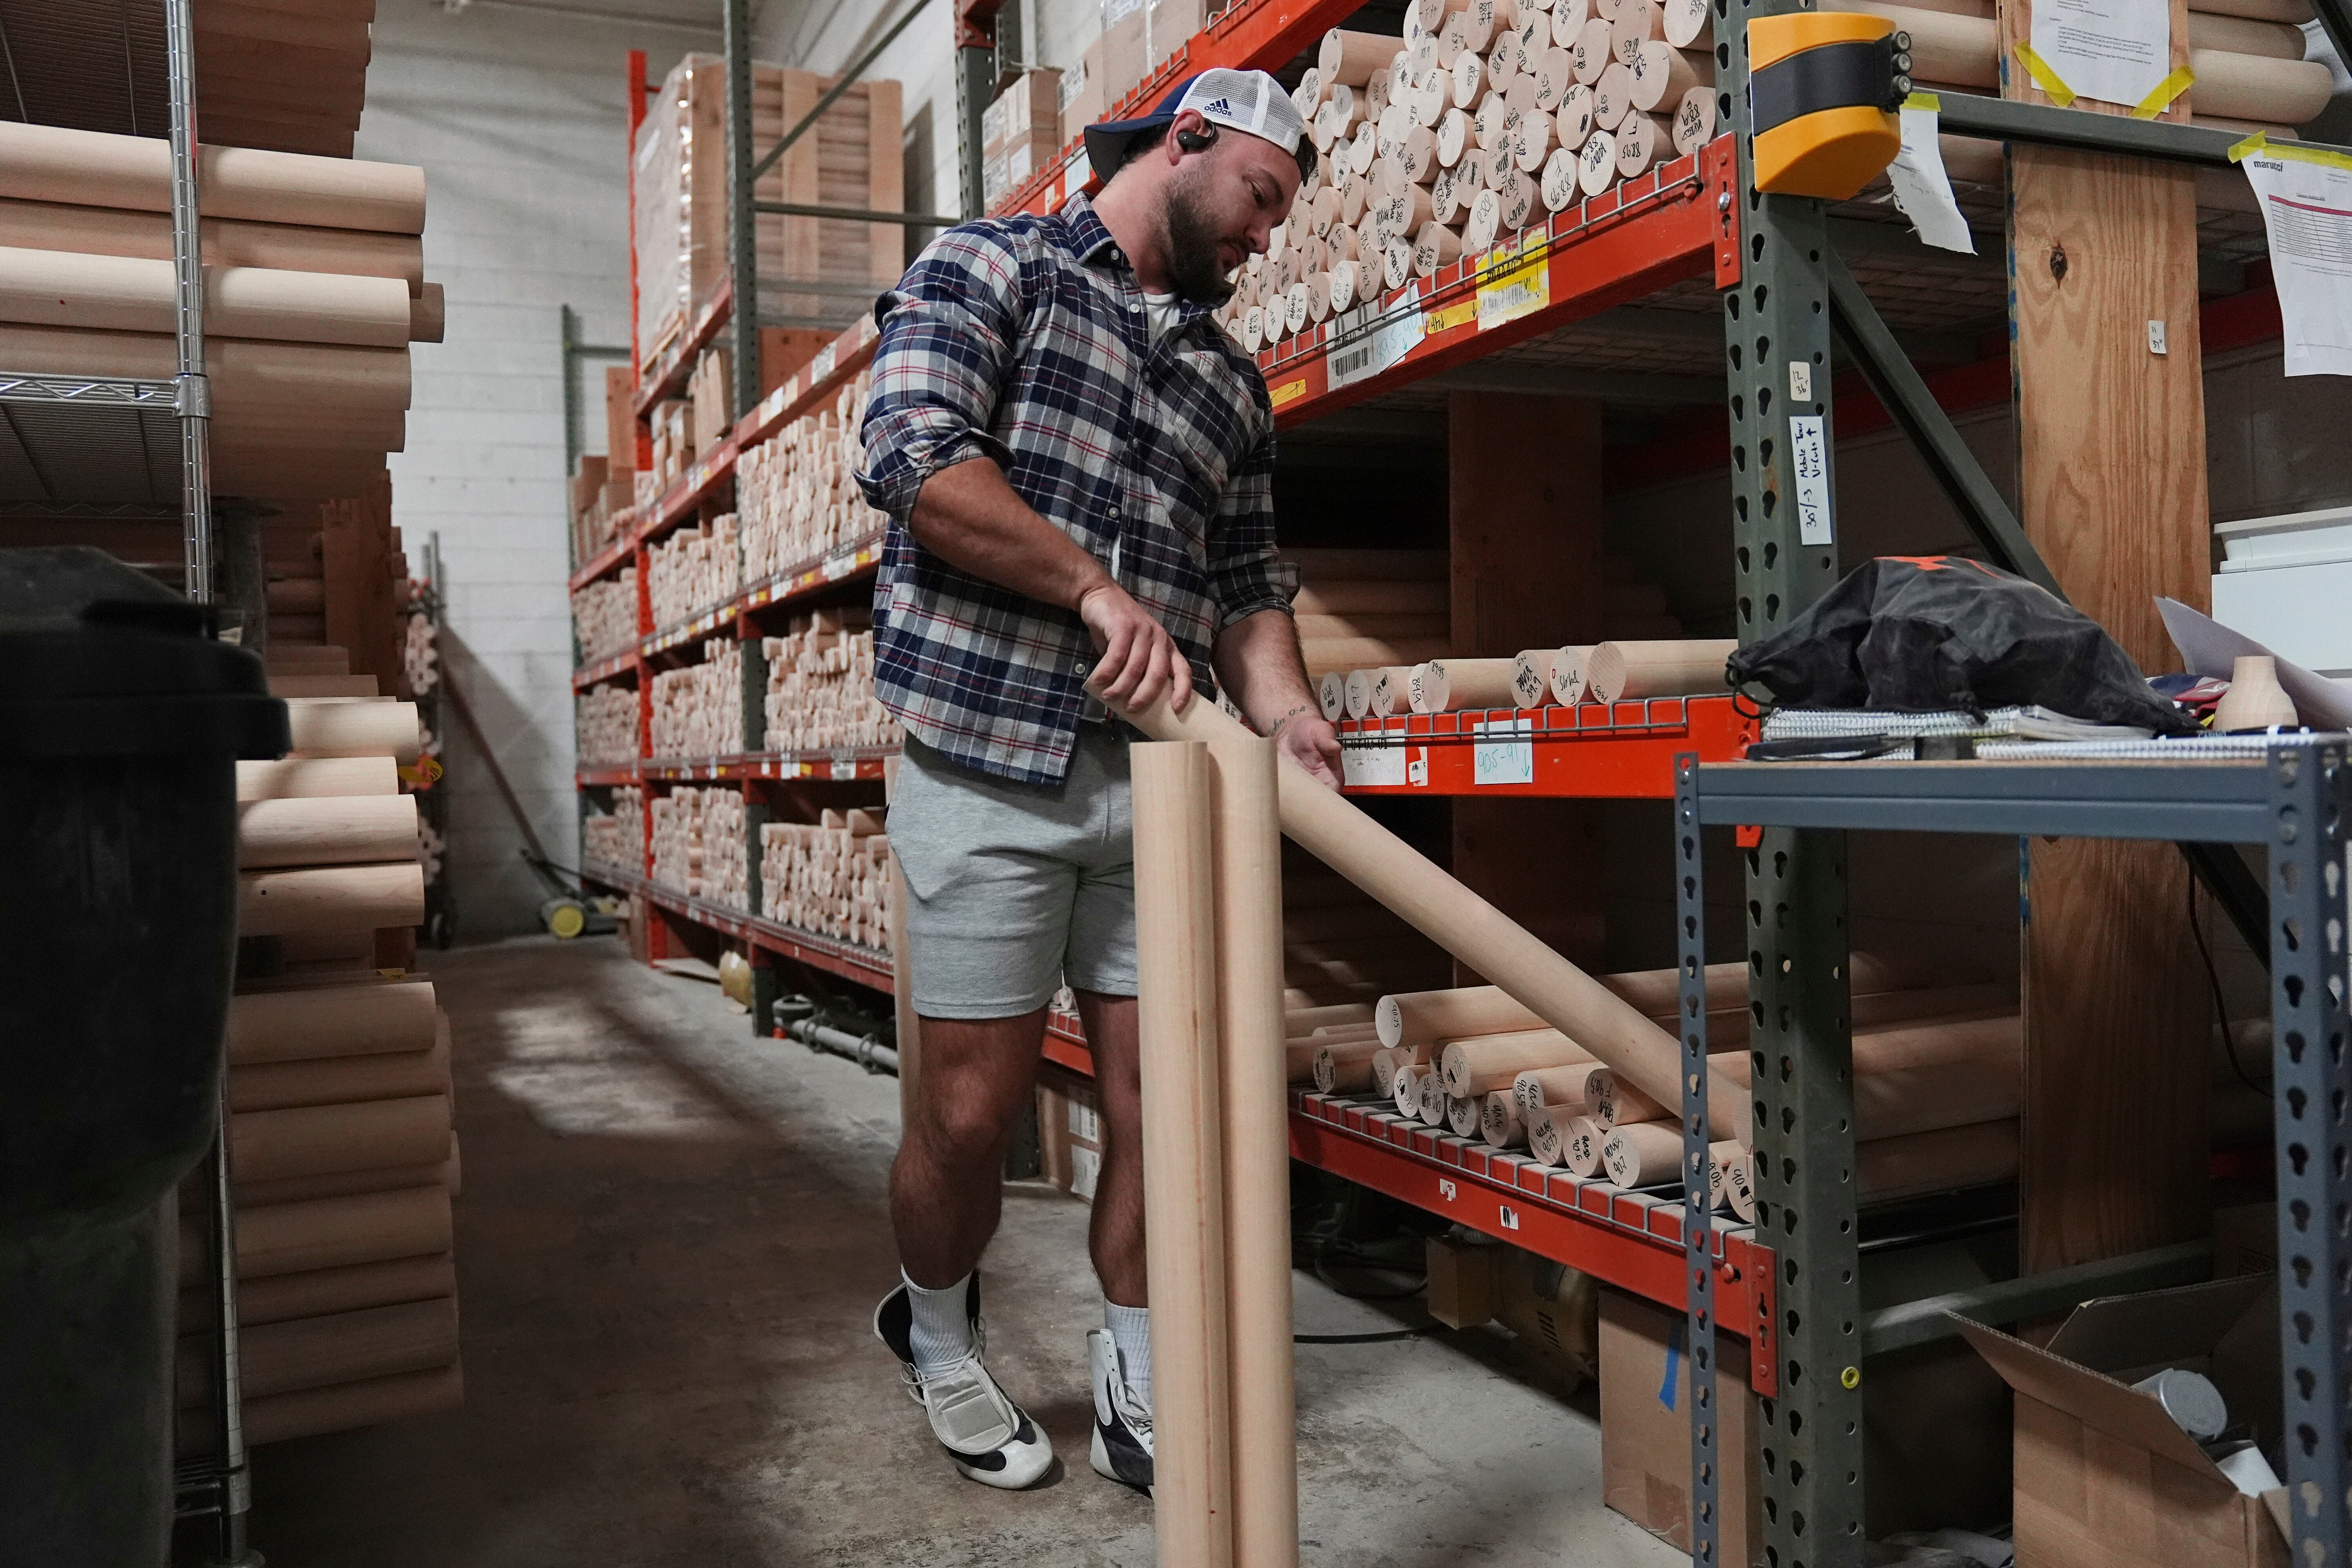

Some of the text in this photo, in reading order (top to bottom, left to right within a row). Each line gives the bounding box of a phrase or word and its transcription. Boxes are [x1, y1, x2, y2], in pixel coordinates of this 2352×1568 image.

[1204, 106, 1232, 116] adidas
[2254, 161, 2283, 172] marucci
[1793, 370, 1803, 381] 12
[1798, 448, 1808, 478] Mobile
[1412, 679, 1422, 704] 89.9
[1526, 676, 1542, 699] 89.9
[1391, 1005, 1400, 1027] 90.75
[1516, 1079, 1527, 1107] 90.55
[1573, 1139, 1583, 1161] 90.6
